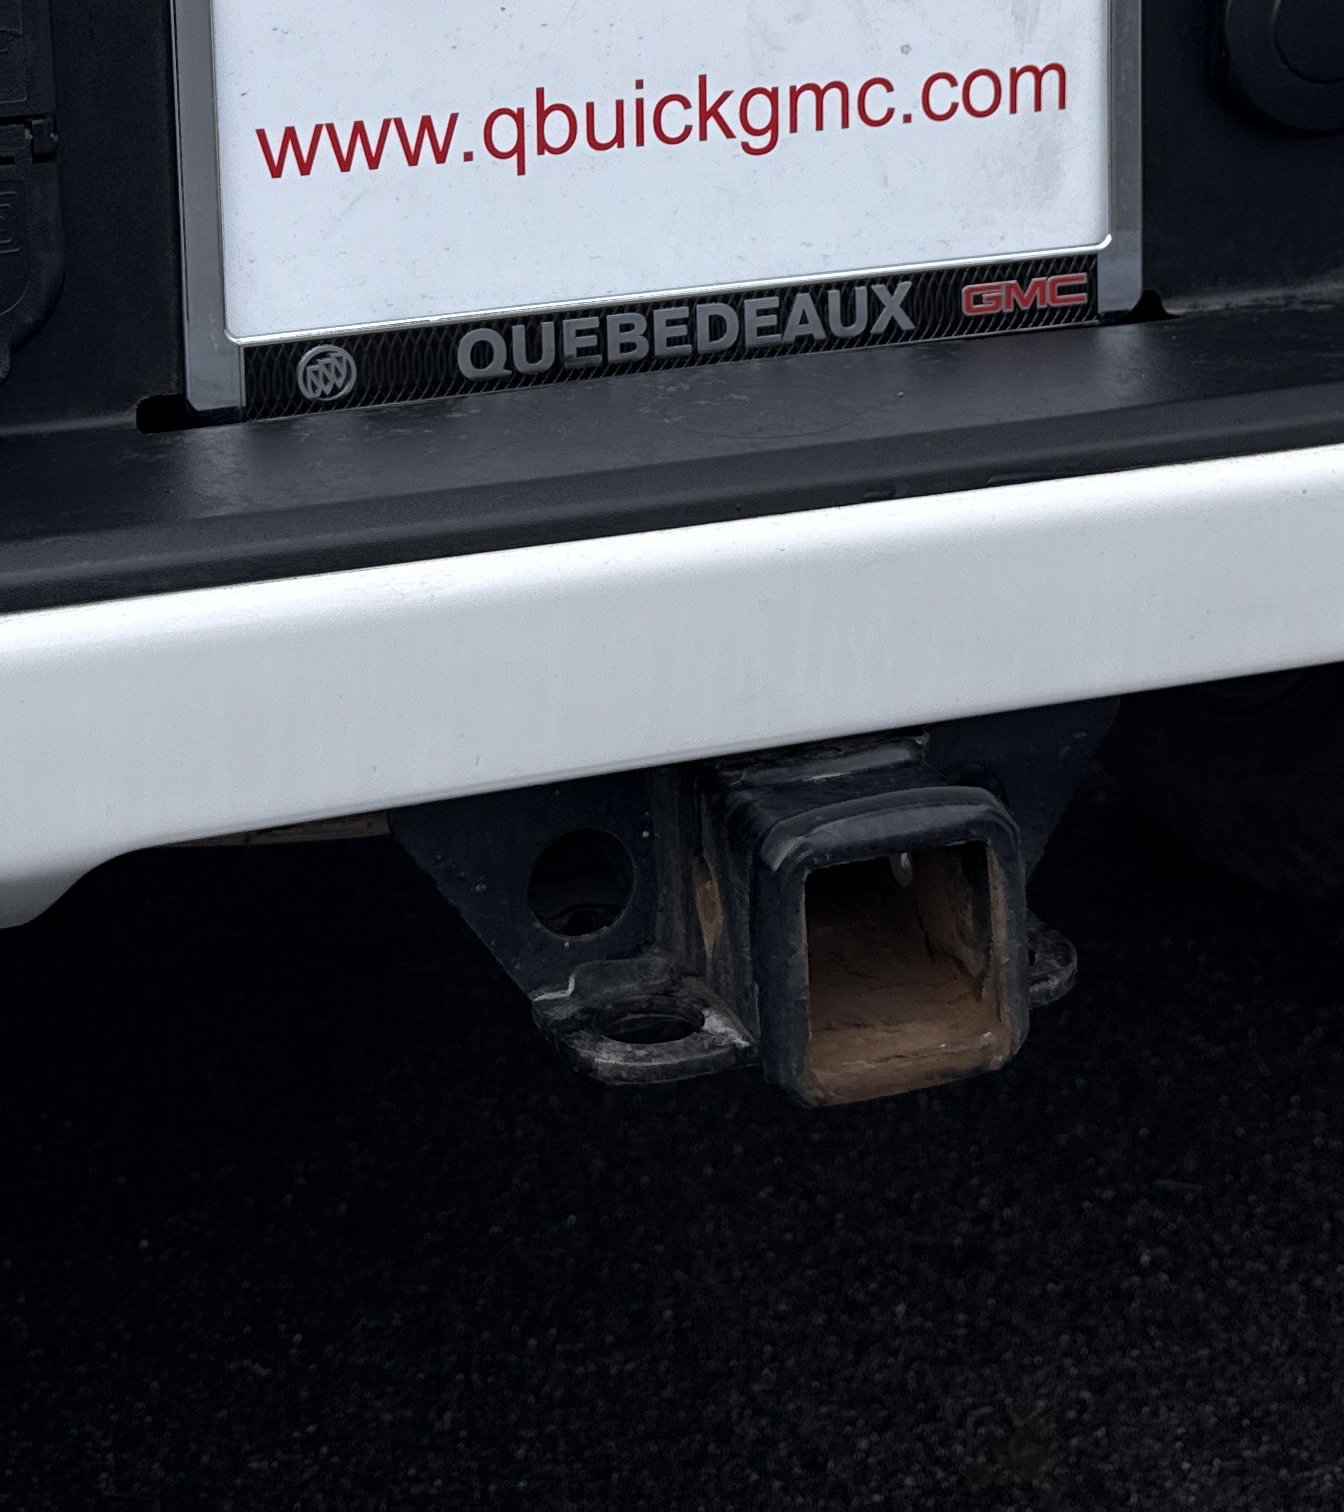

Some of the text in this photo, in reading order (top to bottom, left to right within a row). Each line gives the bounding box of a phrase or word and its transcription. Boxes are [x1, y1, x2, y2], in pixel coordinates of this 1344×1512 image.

[254, 61, 1068, 181] www.qbuickgmc.com
[456, 280, 915, 381] QUEBEDEAUX
[961, 272, 1088, 317] GMC
